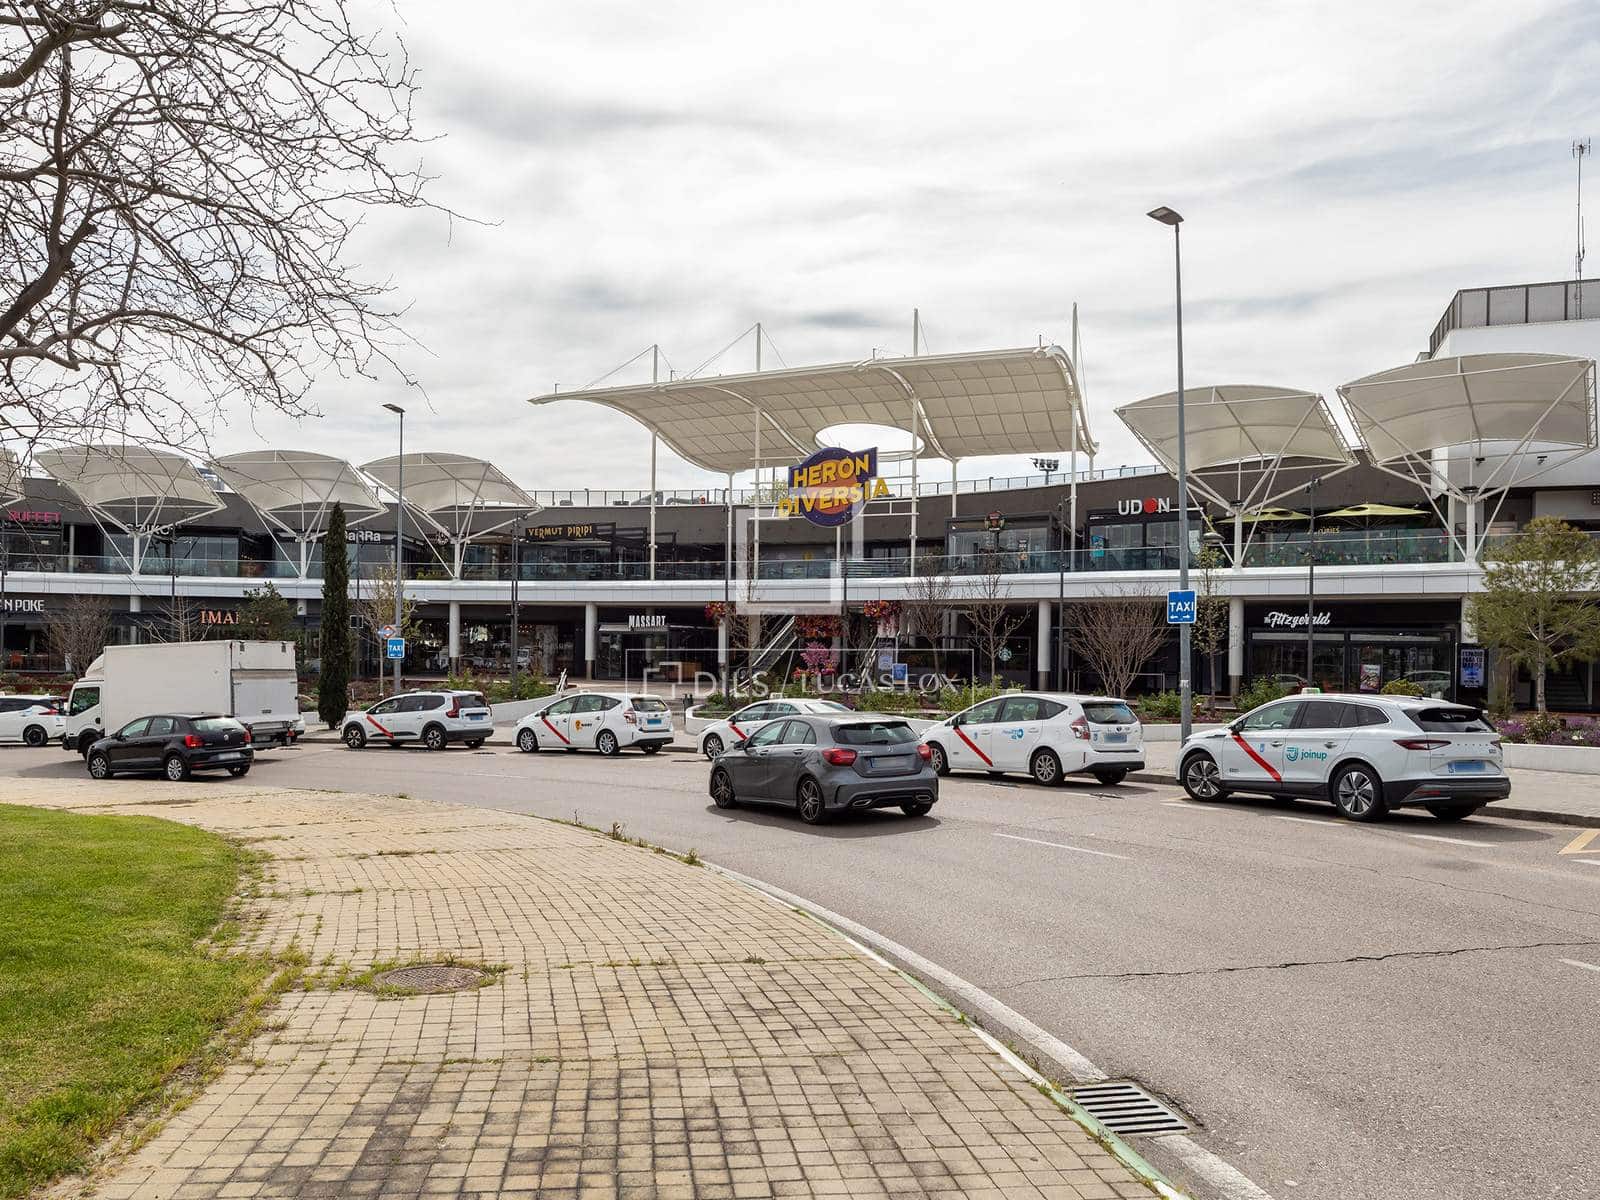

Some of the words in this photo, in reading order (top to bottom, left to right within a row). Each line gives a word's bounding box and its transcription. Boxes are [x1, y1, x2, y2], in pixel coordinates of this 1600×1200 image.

[793, 453, 870, 489] HERON
[778, 477, 890, 518] DIVERSIA
[1117, 497, 1170, 515] UDON
[528, 527, 562, 539] VERMUT
[567, 525, 592, 537] PIRIPI
[15, 599, 45, 611] POKE
[1169, 601, 1194, 612] TAXI
[628, 615, 666, 629] MASSART
[1301, 749, 1328, 760] joinup
